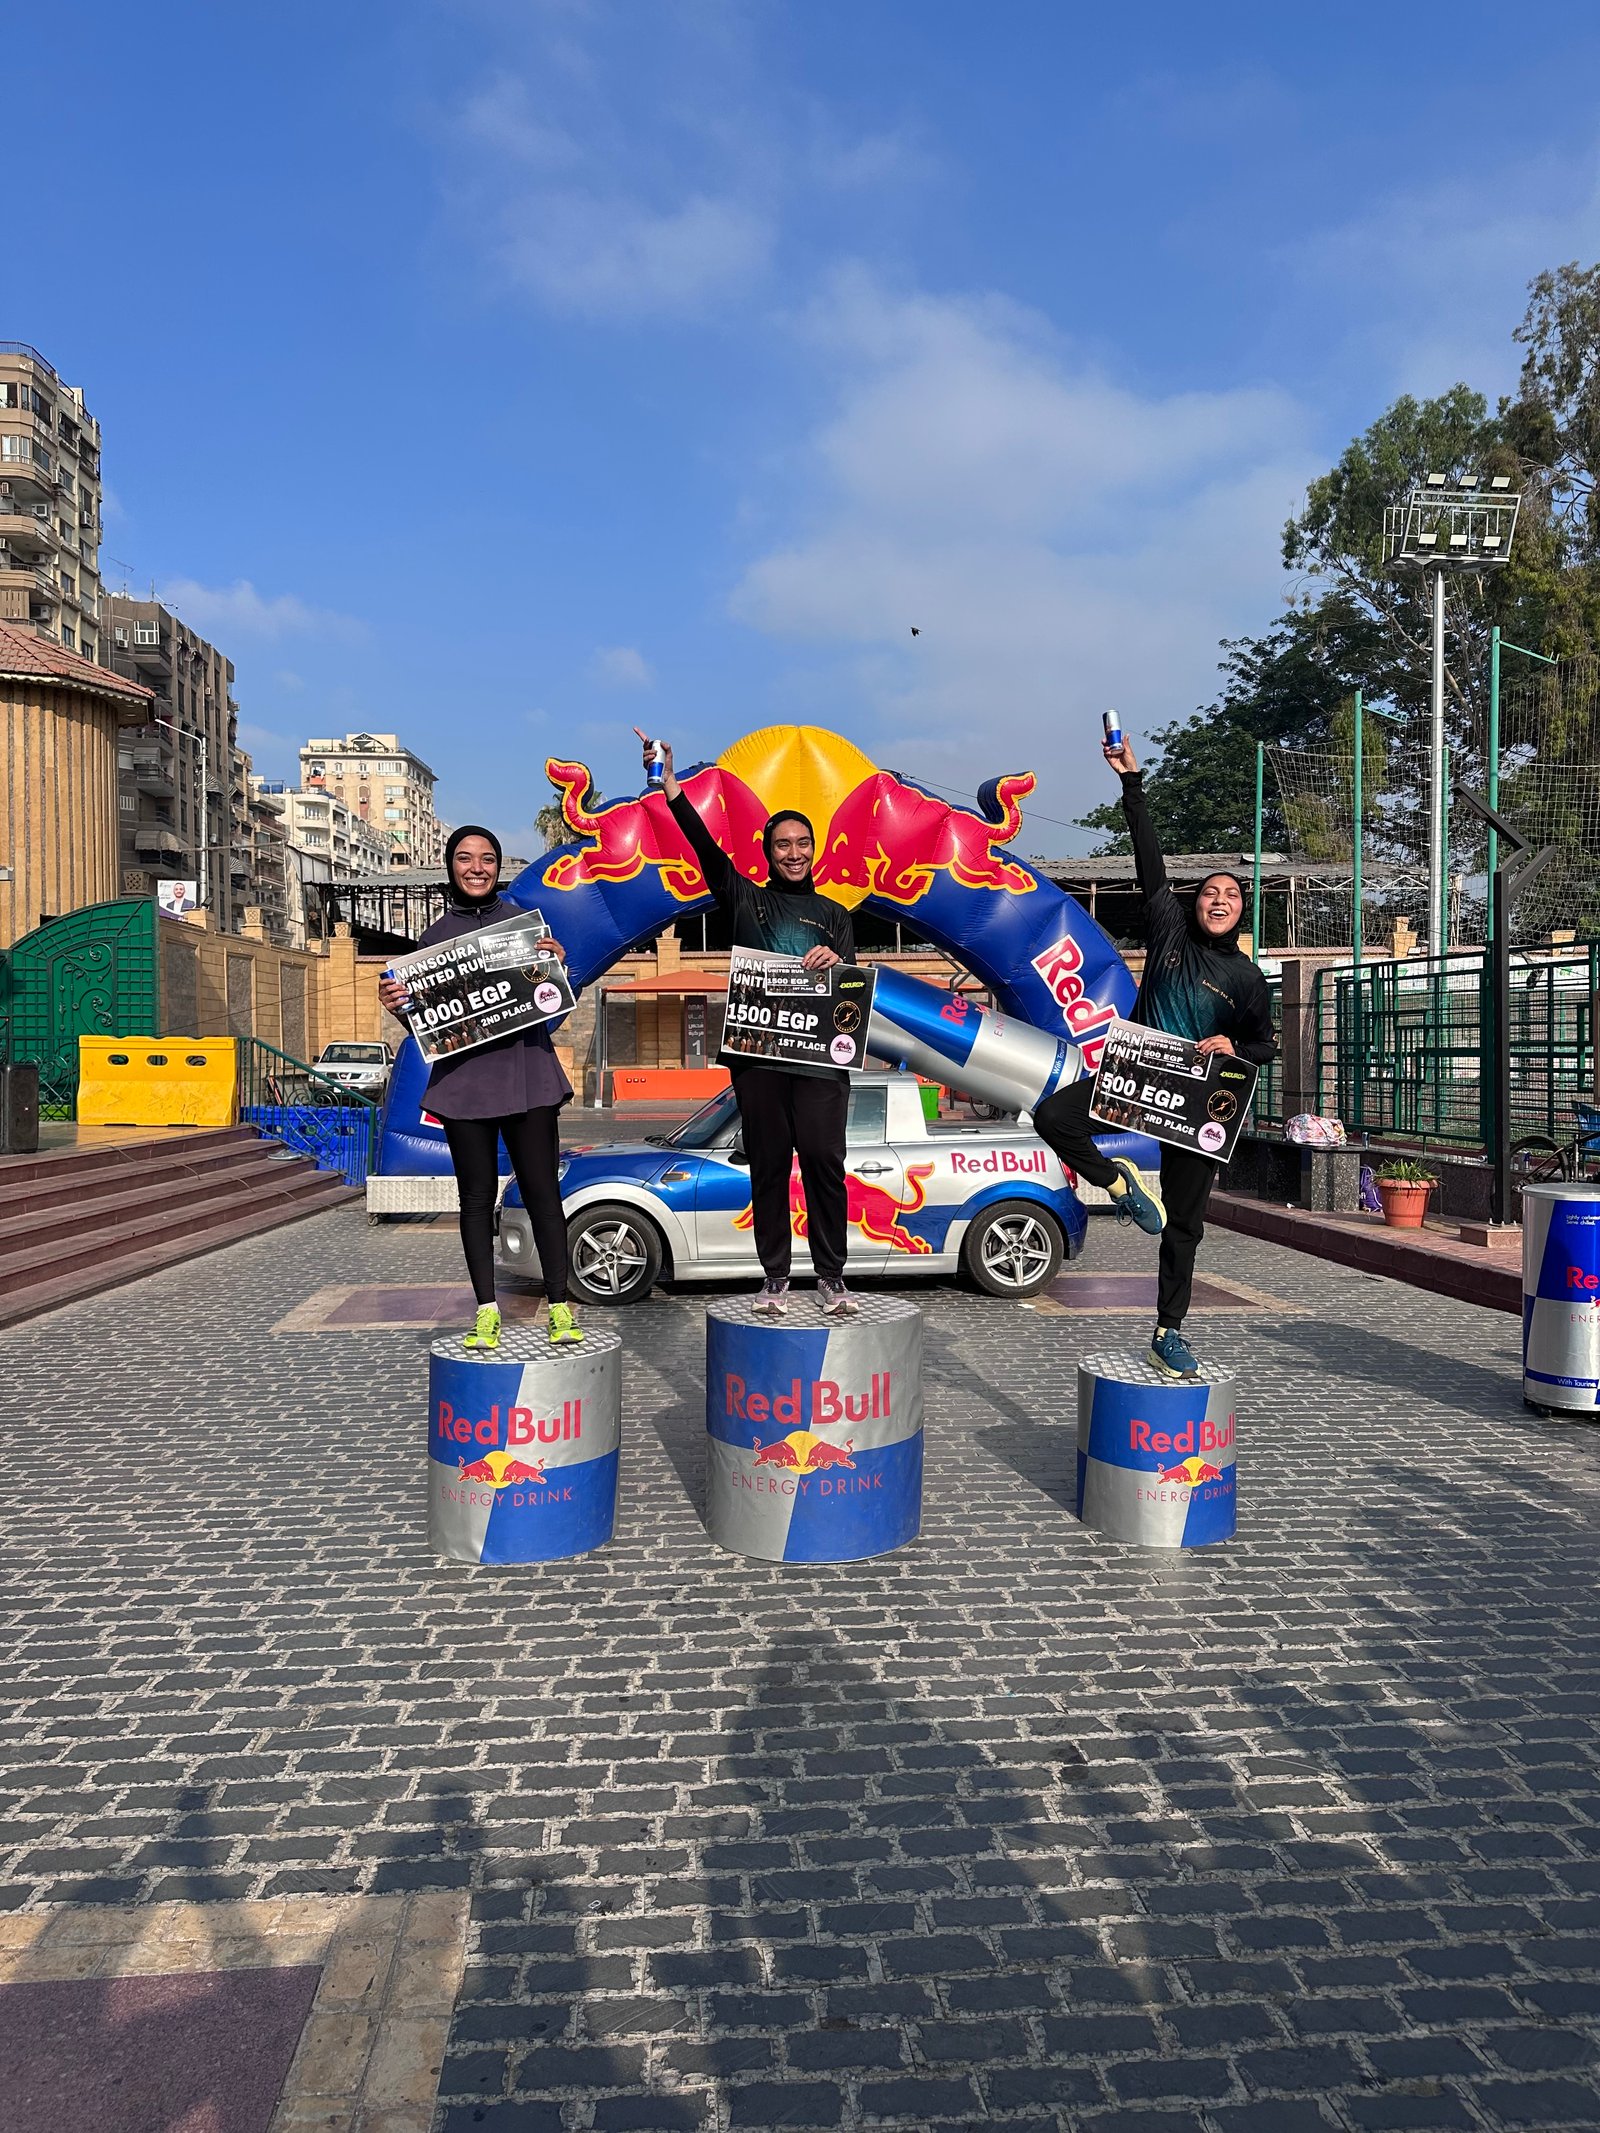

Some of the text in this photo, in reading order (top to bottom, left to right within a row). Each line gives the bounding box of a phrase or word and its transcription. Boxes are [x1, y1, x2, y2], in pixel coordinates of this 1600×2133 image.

[396, 943, 478, 980] MANSOURA
[1035, 936, 1116, 1033] Red
[412, 998, 464, 1031] 1000
[467, 980, 512, 1010] EGP
[481, 1002, 534, 1028] 2ND PLACE
[727, 1003, 819, 1032] 1500 EGP
[692, 1039, 701, 1056] 1
[778, 1038, 796, 1047] 1ST
[796, 1040, 826, 1052] PLACE
[1144, 1050, 1184, 1062] 500 EGP
[1169, 1044, 1184, 1052] RUN
[1101, 1072, 1136, 1097] 500
[1140, 1083, 1186, 1111] EGP
[1143, 1113, 1163, 1126] 3RD
[1164, 1118, 1196, 1136] PLACE
[950, 1150, 1046, 1174] Red Bull
[1557, 1378, 1573, 1386] With
[725, 1371, 890, 1425] Red Bull
[438, 1398, 582, 1446] Red Bull
[1130, 1412, 1235, 1454] Red Bull
[732, 1472, 884, 1496] ENERGY DRINK
[1136, 1488, 1200, 1503] ENERGY
[441, 1486, 573, 1508] ENERGY DRINK
